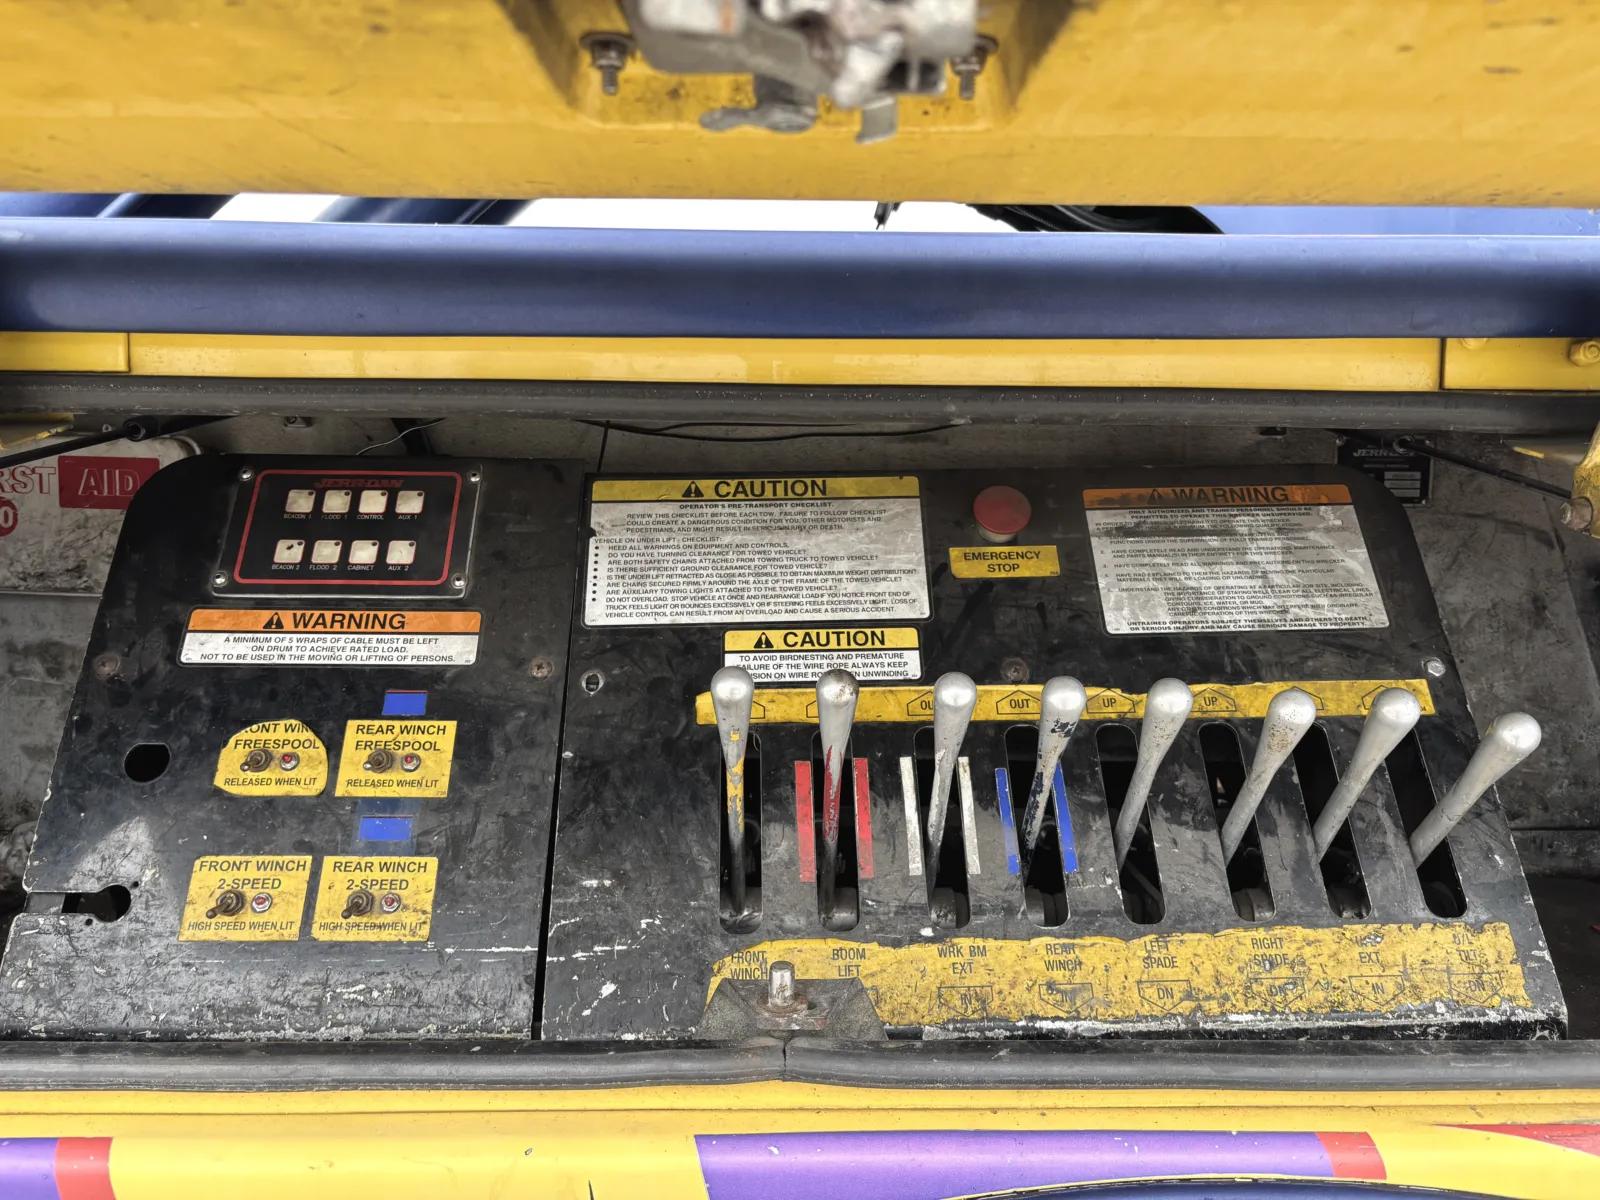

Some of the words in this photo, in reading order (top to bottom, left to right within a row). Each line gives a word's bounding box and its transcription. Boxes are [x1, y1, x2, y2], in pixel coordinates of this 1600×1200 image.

[78, 468, 141, 496] AID
[714, 480, 826, 498] CAUTION
[1172, 487, 1288, 504] WARNING
[964, 551, 1041, 560] EMERGENCY
[987, 564, 1020, 572] STOP
[292, 612, 406, 630] WARNING
[783, 630, 885, 648] CAUTION
[920, 700, 934, 710] OU
[1010, 699, 1030, 709] OUT
[1103, 697, 1116, 707] UP
[1204, 696, 1218, 707] UP
[244, 723, 280, 734] ONT
[284, 723, 309, 734] WIN
[356, 724, 395, 735] REAR
[399, 725, 446, 735] WINCH
[234, 739, 320, 750] FREESPOOL
[355, 741, 441, 751] FREESPOOL
[224, 778, 272, 786] RELEASED
[275, 778, 301, 786] WHEN
[303, 778, 317, 786] LIT
[346, 779, 394, 788] RELEASED
[397, 779, 423, 788] WHEN
[425, 780, 439, 788] LIT
[199, 860, 251, 871] FRONT
[255, 860, 306, 871] WINCH
[333, 862, 374, 872] REAR
[379, 862, 427, 872] WINCH
[218, 879, 281, 889] 2-SPEED
[346, 879, 409, 890] 2-SPEED
[188, 921, 213, 930] HIGH
[214, 921, 246, 931] SPEED
[248, 921, 277, 931] WHEN
[279, 921, 294, 931] LIT
[319, 922, 342, 931] HIGH
[345, 922, 375, 931] SPEED
[378, 922, 406, 931] WHEN
[409, 922, 424, 931] LIT
[1144, 940, 1169, 952] LEFT
[1251, 938, 1283, 949] RIGHT
[832, 948, 866, 960] BOOM
[937, 945, 963, 957] WRK
[969, 945, 987, 957] BM
[1046, 944, 1076, 955] REAR
[731, 951, 766, 962] FRONT
[1254, 954, 1290, 966] SPADE
[1359, 952, 1379, 963] EXT
[952, 962, 973, 974] EXT
[1044, 960, 1082, 971] WINCH
[1142, 957, 1178, 969] SPADE
[730, 968, 768, 979] WINCH
[838, 965, 861, 977] LIFT
[1157, 987, 1174, 999] DN
[1372, 983, 1384, 994] IN
